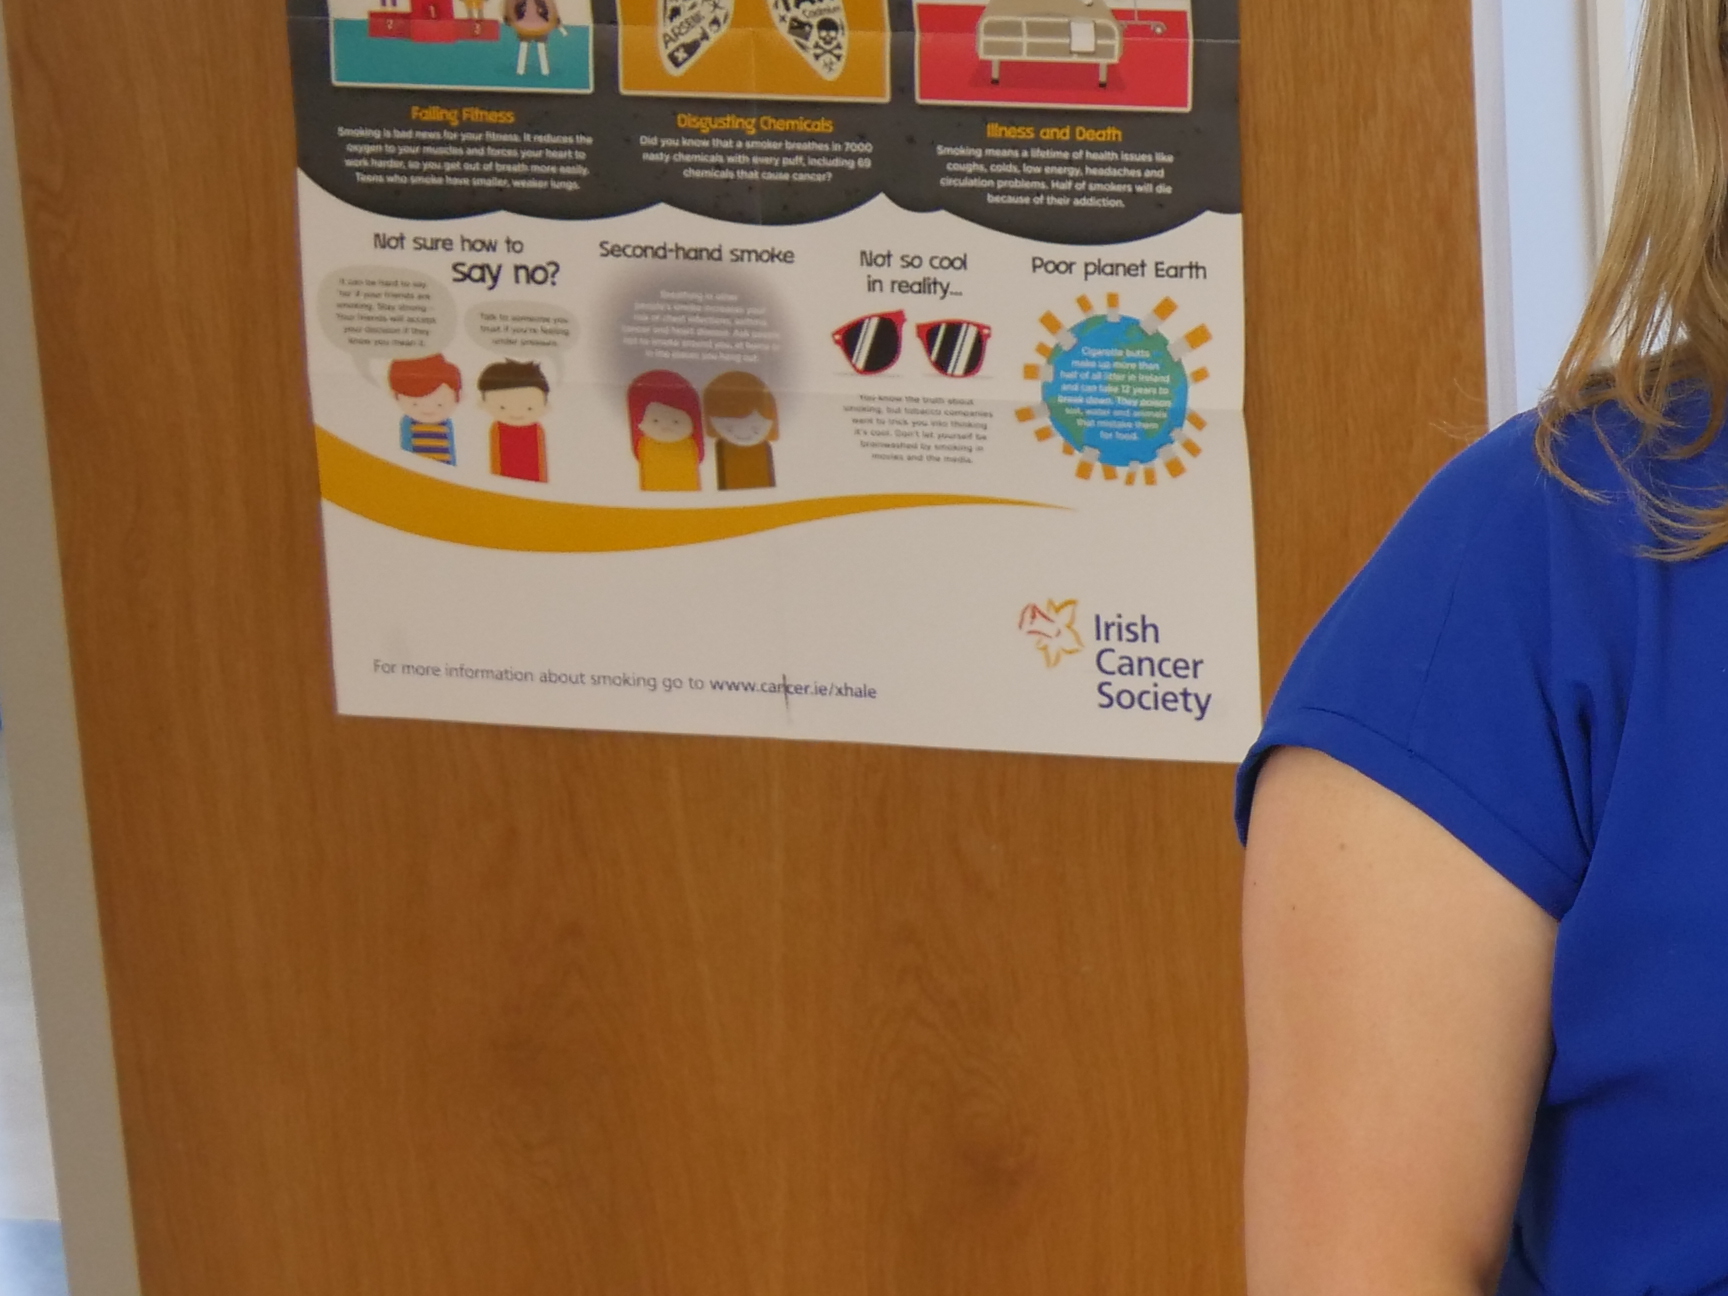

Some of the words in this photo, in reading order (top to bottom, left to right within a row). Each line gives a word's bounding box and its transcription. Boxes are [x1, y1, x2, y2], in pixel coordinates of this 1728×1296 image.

[462, 107, 515, 124] Fitness
[676, 113, 755, 135] Disgusting
[760, 115, 834, 133] Chemicals
[986, 123, 1034, 140] Illness
[1040, 126, 1070, 141] and
[1076, 126, 1123, 142] Death
[373, 232, 406, 251] Not
[412, 235, 454, 252] sure
[460, 235, 498, 253] how
[503, 237, 524, 253] to
[599, 241, 722, 263] Second-hand
[730, 245, 795, 265] smoke
[859, 250, 893, 268] Not
[900, 253, 922, 270] so
[928, 252, 968, 271] cool
[1031, 256, 1078, 276] Poor
[1083, 259, 1146, 281] planet
[1154, 262, 1207, 281] Earth
[451, 262, 501, 290] say
[514, 261, 560, 287] no?
[867, 275, 884, 294] in
[1095, 613, 1159, 644] Irish
[373, 659, 396, 674] For
[402, 663, 441, 677] more
[445, 663, 534, 682] information
[539, 669, 585, 685] about
[591, 672, 656, 691] smoking
[662, 677, 683, 692] go
[689, 677, 704, 690] to
[1096, 648, 1204, 679] Cancer
[1097, 681, 1212, 721] Society
